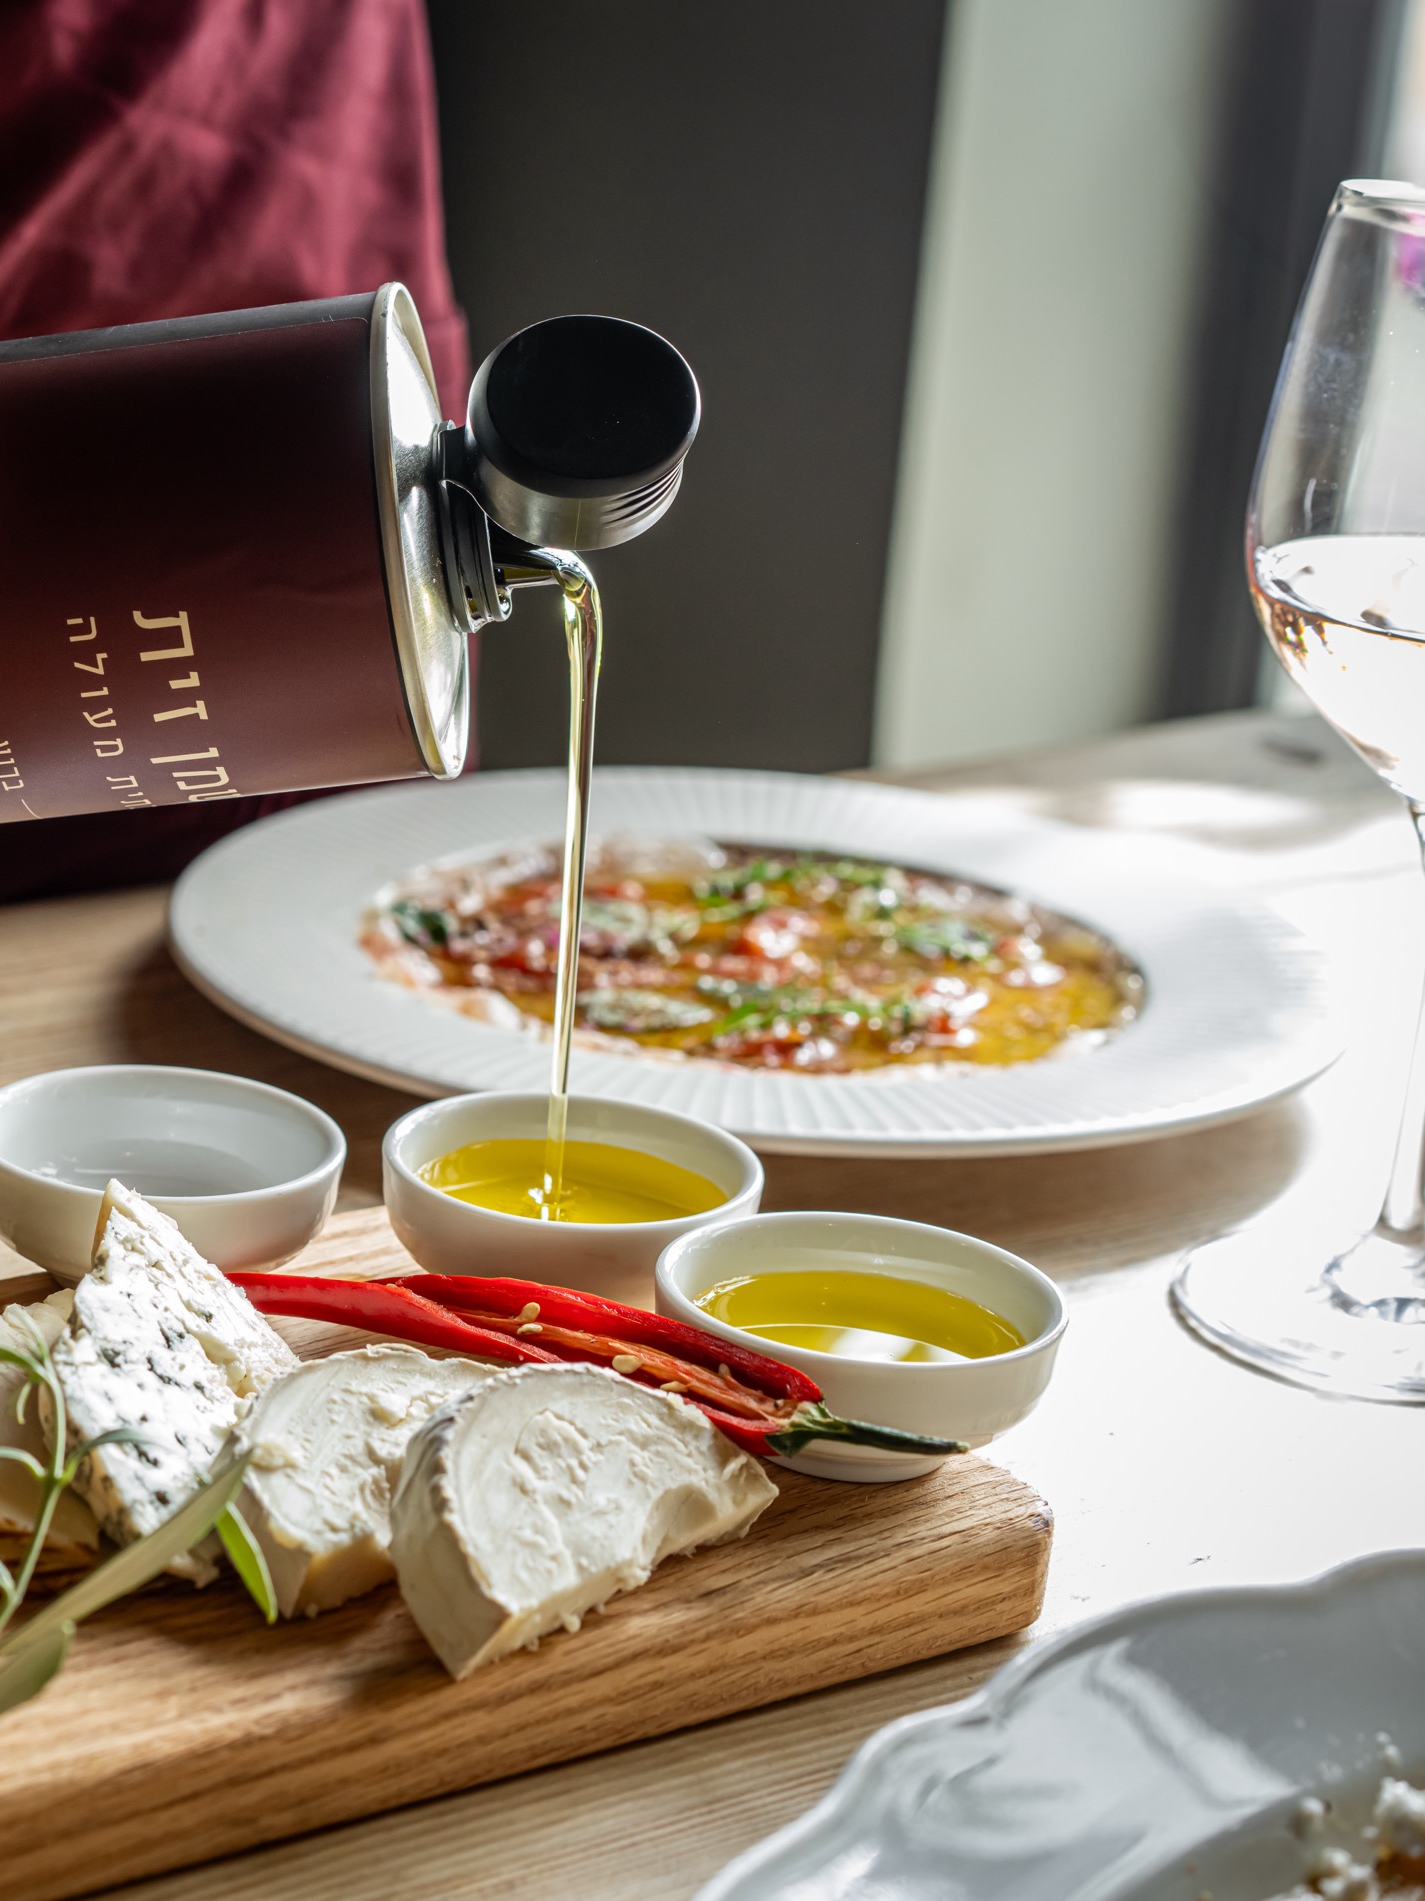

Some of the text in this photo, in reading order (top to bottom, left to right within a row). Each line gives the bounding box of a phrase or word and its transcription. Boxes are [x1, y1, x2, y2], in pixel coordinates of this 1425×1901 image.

[67, 616, 155, 808] תית מעולה
[132, 610, 209, 723] זית
